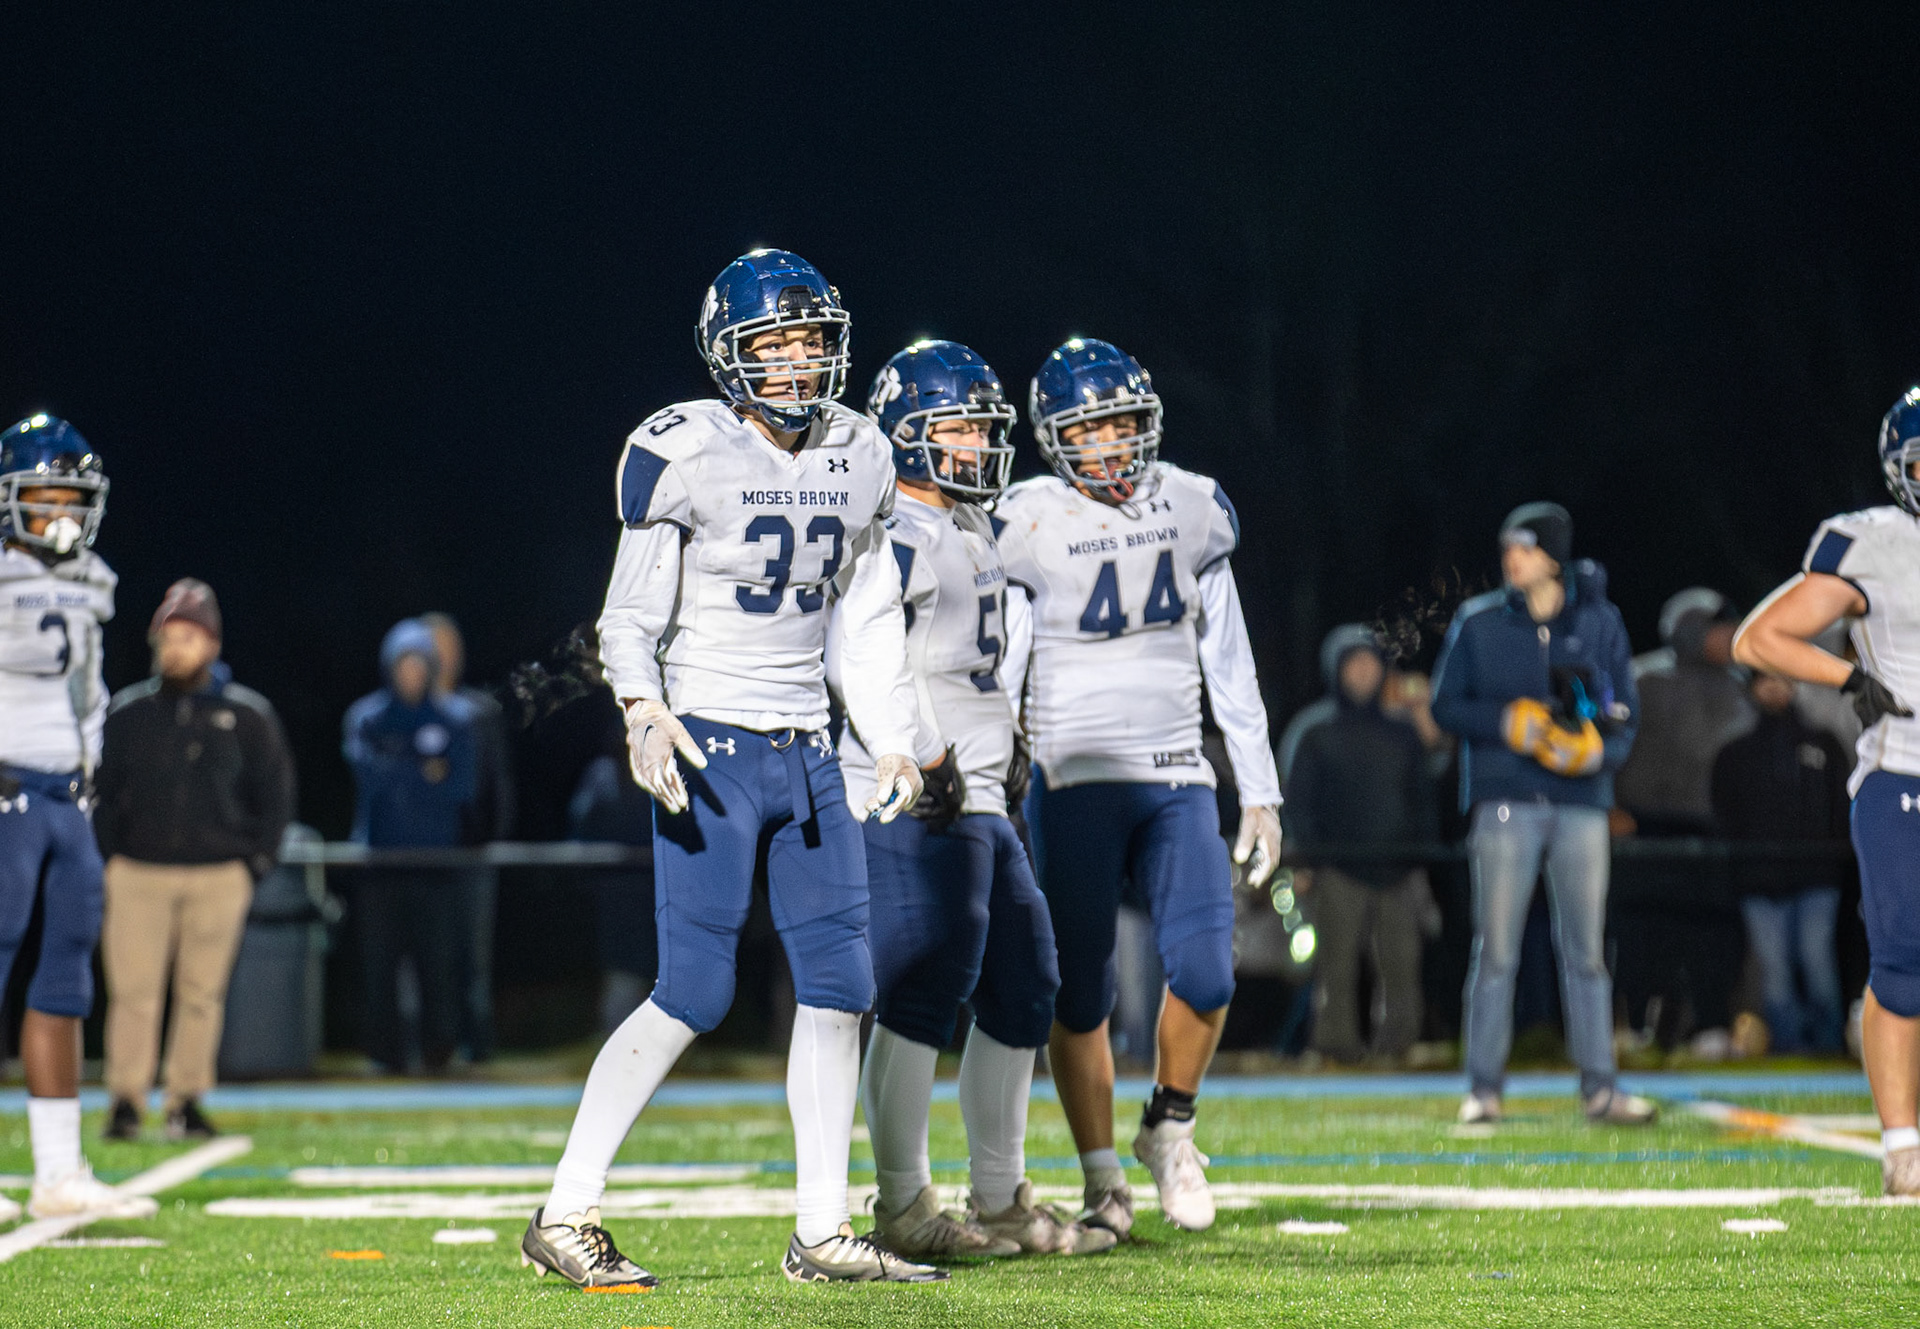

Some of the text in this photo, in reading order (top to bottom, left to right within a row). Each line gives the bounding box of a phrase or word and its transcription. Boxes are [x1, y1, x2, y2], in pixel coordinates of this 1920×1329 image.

[741, 490, 849, 506] MOSES BROWN
[1067, 526, 1179, 556] MOSES BROWN
[734, 514, 846, 615] 33
[1079, 548, 1187, 638] 44
[970, 590, 1007, 692] 5
